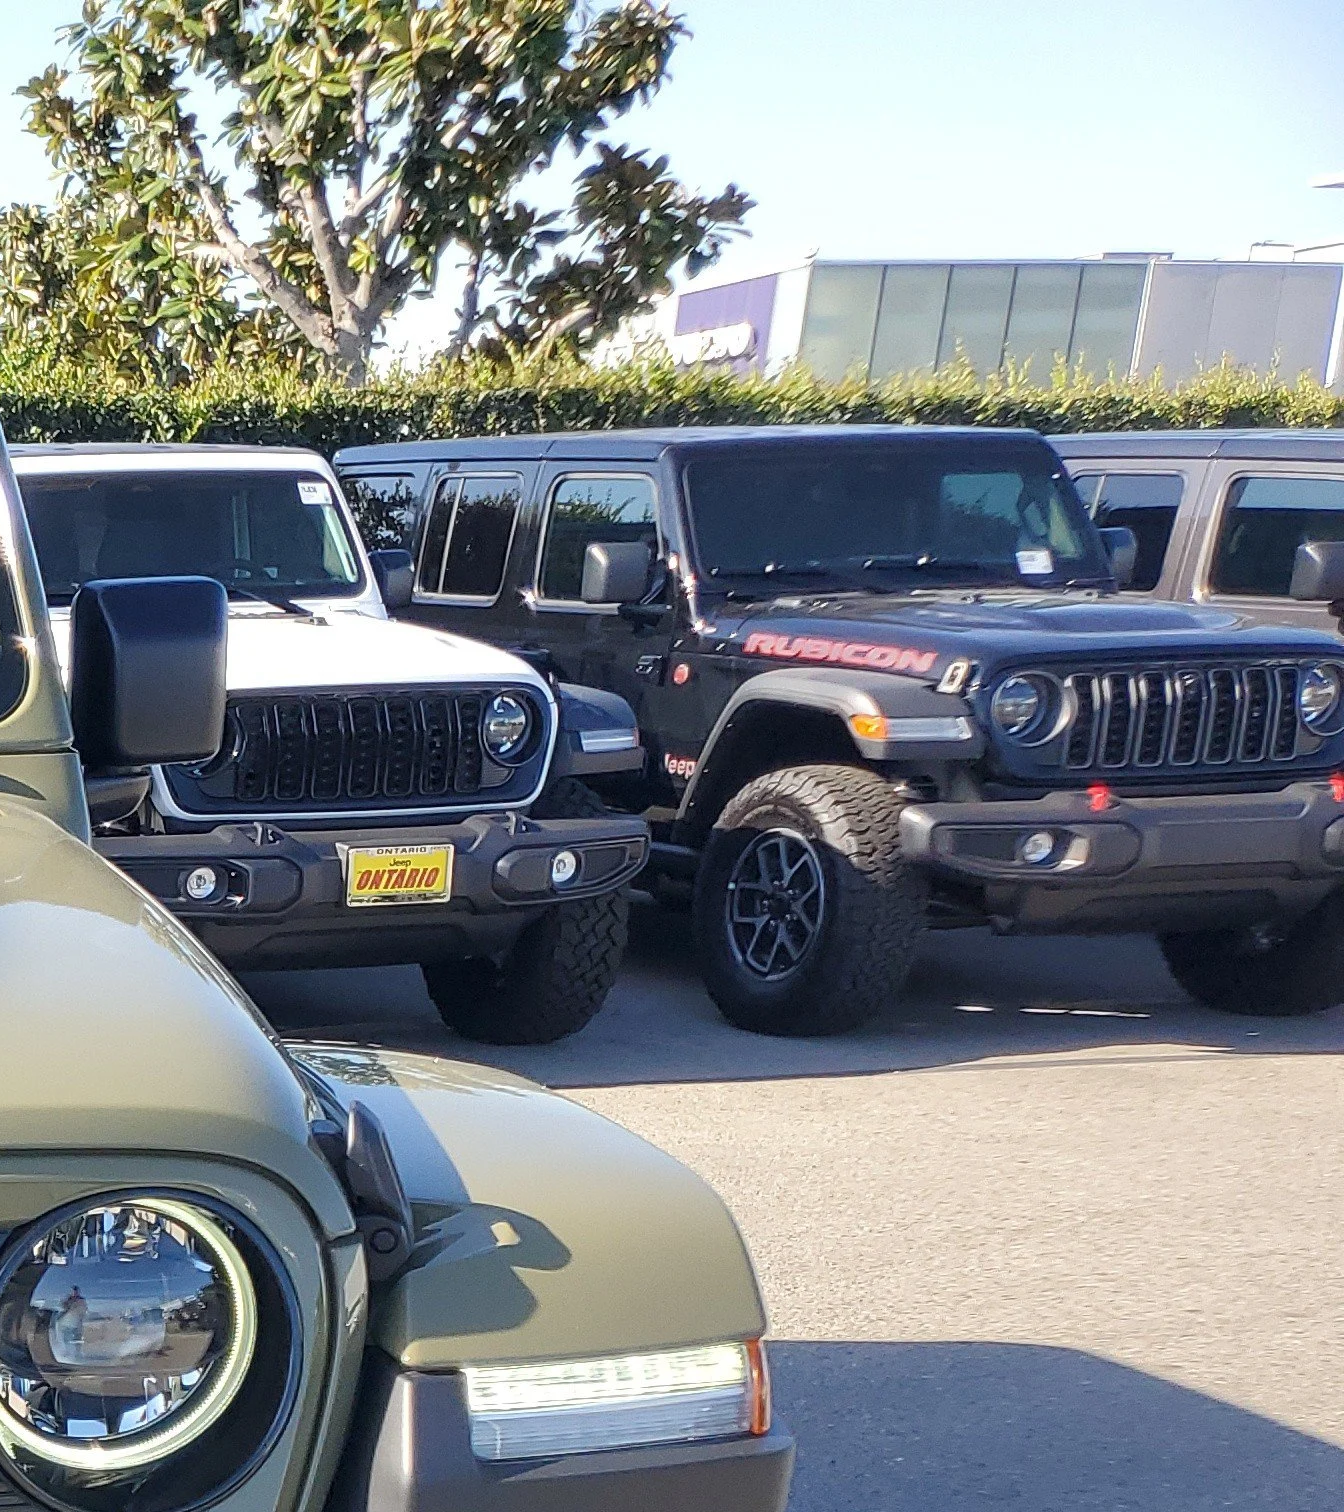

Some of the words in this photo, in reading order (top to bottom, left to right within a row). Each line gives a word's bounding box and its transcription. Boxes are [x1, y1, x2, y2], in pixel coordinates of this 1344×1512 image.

[742, 632, 939, 673] RUBICON
[376, 846, 427, 855] ONTARIO
[389, 858, 412, 868] Jeep
[356, 867, 440, 891] ONTARIO
